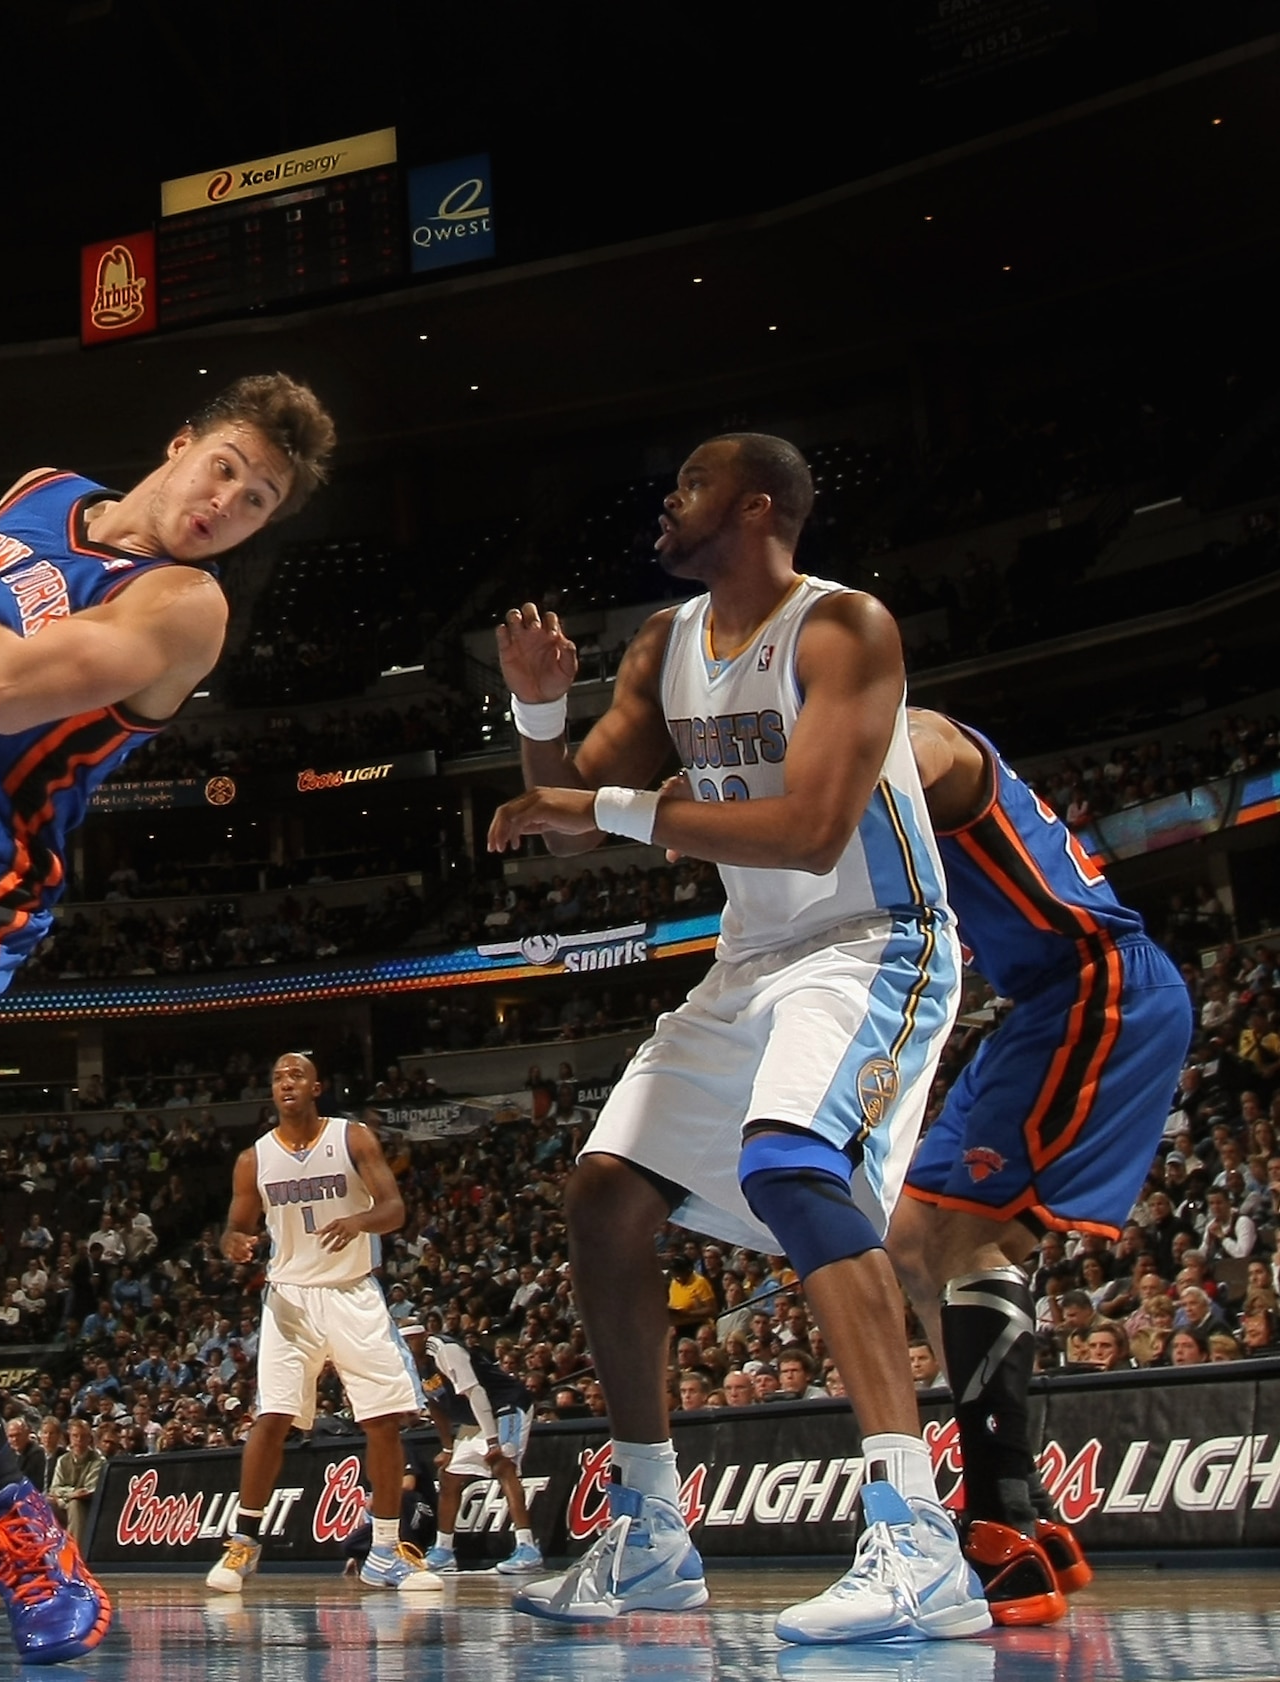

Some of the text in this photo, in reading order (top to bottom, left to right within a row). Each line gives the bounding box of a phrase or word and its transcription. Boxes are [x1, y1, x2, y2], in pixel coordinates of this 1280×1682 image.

[961, 25, 1022, 58] 41513
[239, 152, 341, 188] Xcel Energy
[413, 216, 492, 249] Qwest
[93, 281, 142, 315] Arby's
[296, 763, 394, 793] Coors LIGHT
[564, 940, 648, 973] sports
[578, 1085, 612, 1103] BALK
[265, 1173, 348, 1207] NUGGETS
[301, 1206, 317, 1234] 1
[1102, 1433, 1280, 1515] LIGH
[117, 1468, 204, 1547] Coors
[704, 1457, 866, 1527] LIGHT
